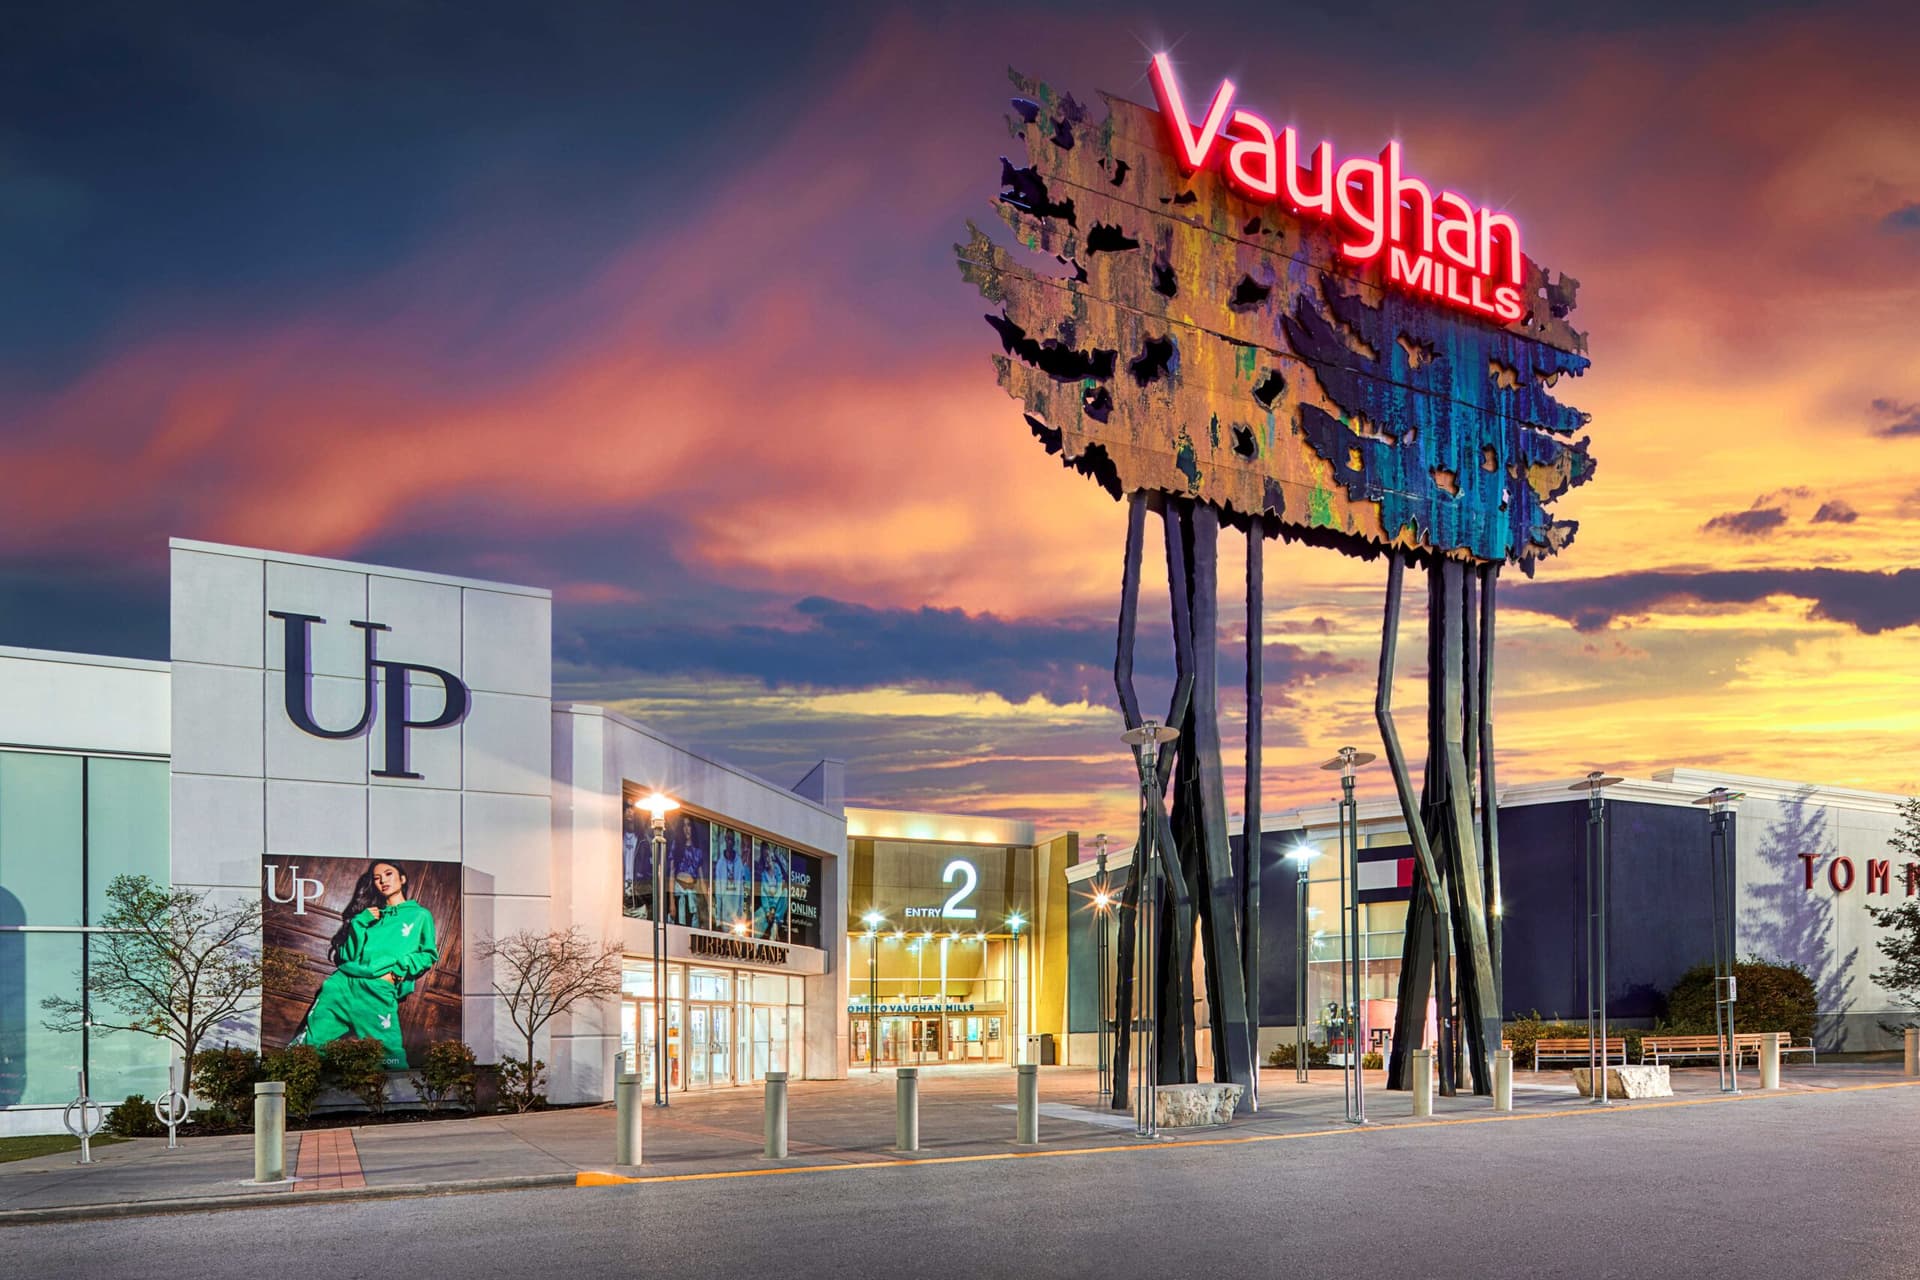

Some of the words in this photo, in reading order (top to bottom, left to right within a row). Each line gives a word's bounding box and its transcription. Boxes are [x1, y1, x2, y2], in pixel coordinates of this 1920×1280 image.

[1149, 52, 1521, 284] Vaughan
[1389, 247, 1522, 321] MILLS
[268, 609, 470, 779] UP
[264, 864, 325, 915] UP
[791, 871, 811, 885] SHOP
[791, 886, 808, 900] 24/7
[905, 907, 942, 918] ENTRY
[942, 859, 977, 919] 2
[791, 901, 817, 918] ONLINE
[689, 934, 744, 959] URBAN
[745, 941, 790, 963] PLANET
[848, 1005, 870, 1013] OME
[890, 1004, 942, 1012] VAUGHAN
[945, 1004, 975, 1012] MILLS
